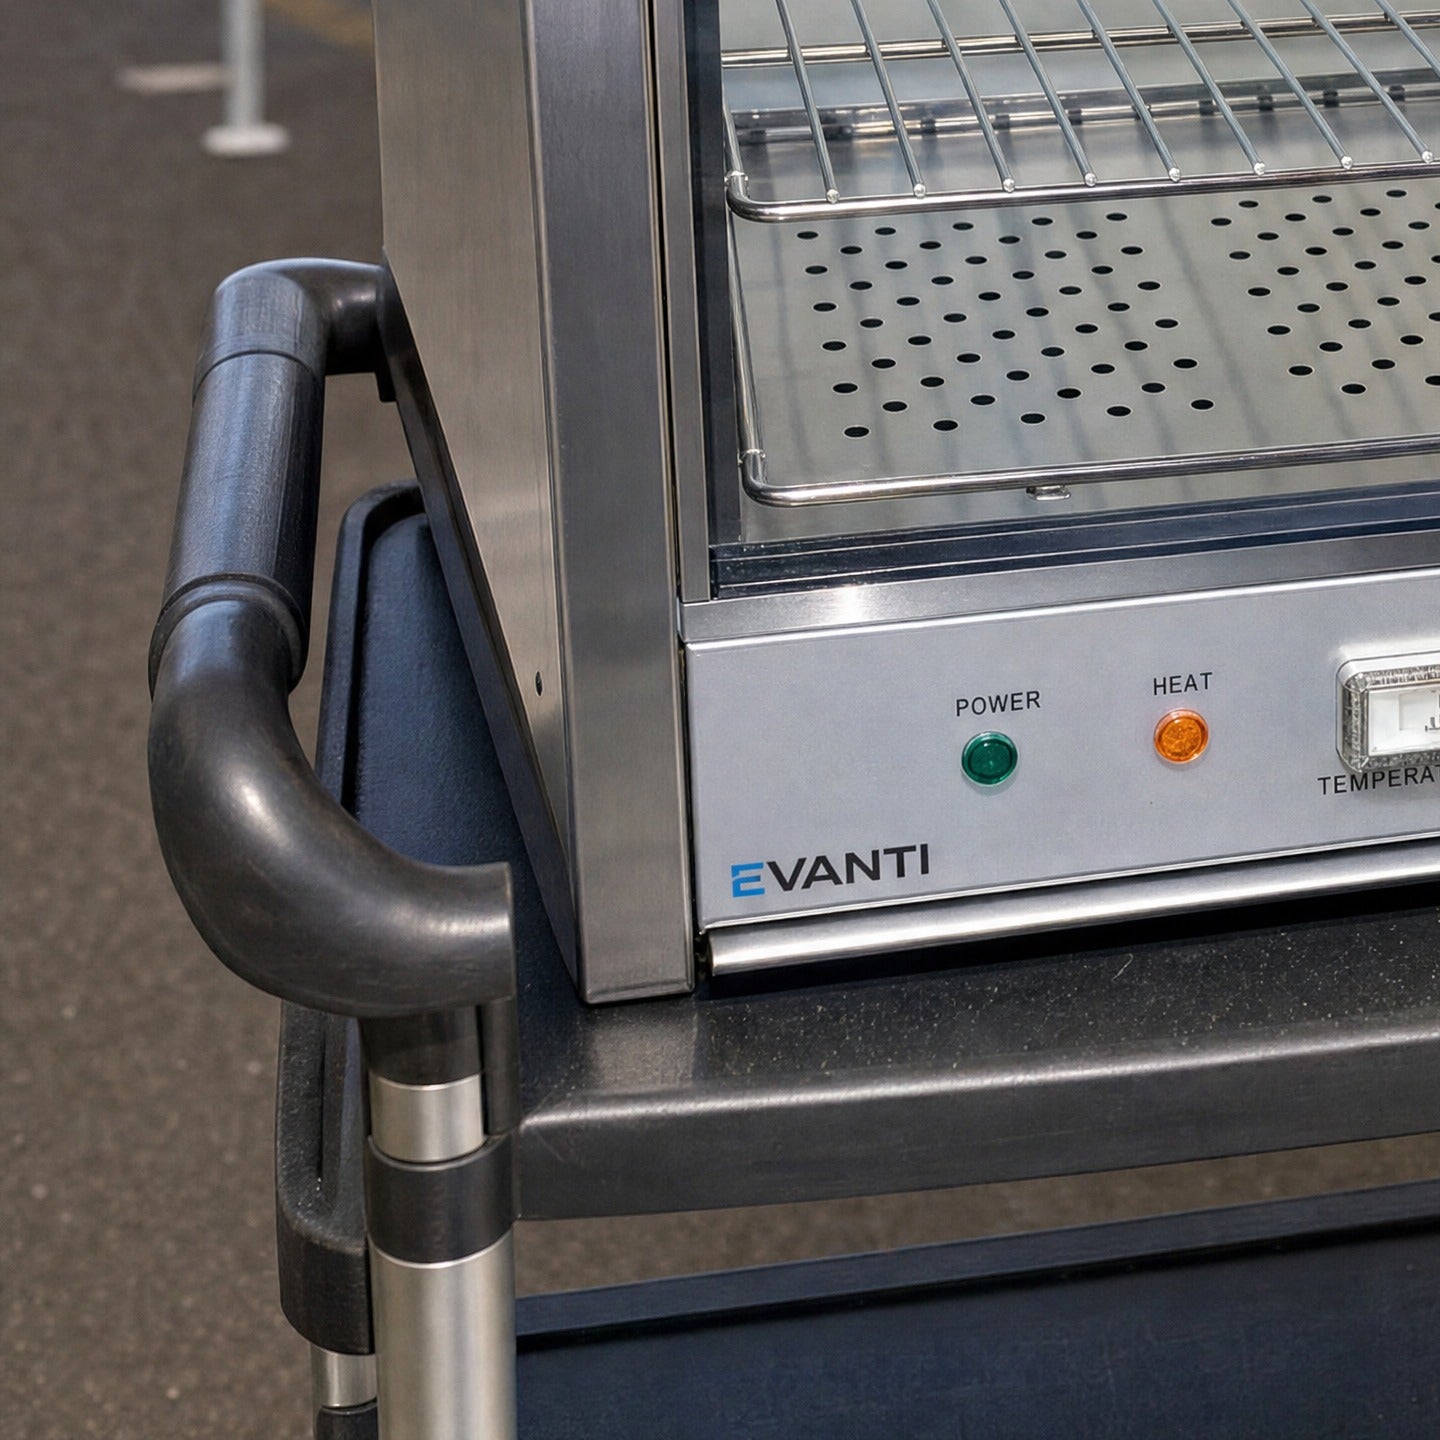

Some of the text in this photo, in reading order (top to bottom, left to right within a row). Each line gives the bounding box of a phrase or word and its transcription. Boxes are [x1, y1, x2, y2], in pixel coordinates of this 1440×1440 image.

[1153, 671, 1213, 696] HEAT
[956, 690, 1041, 716] POWER
[731, 843, 930, 898] EVANTI
